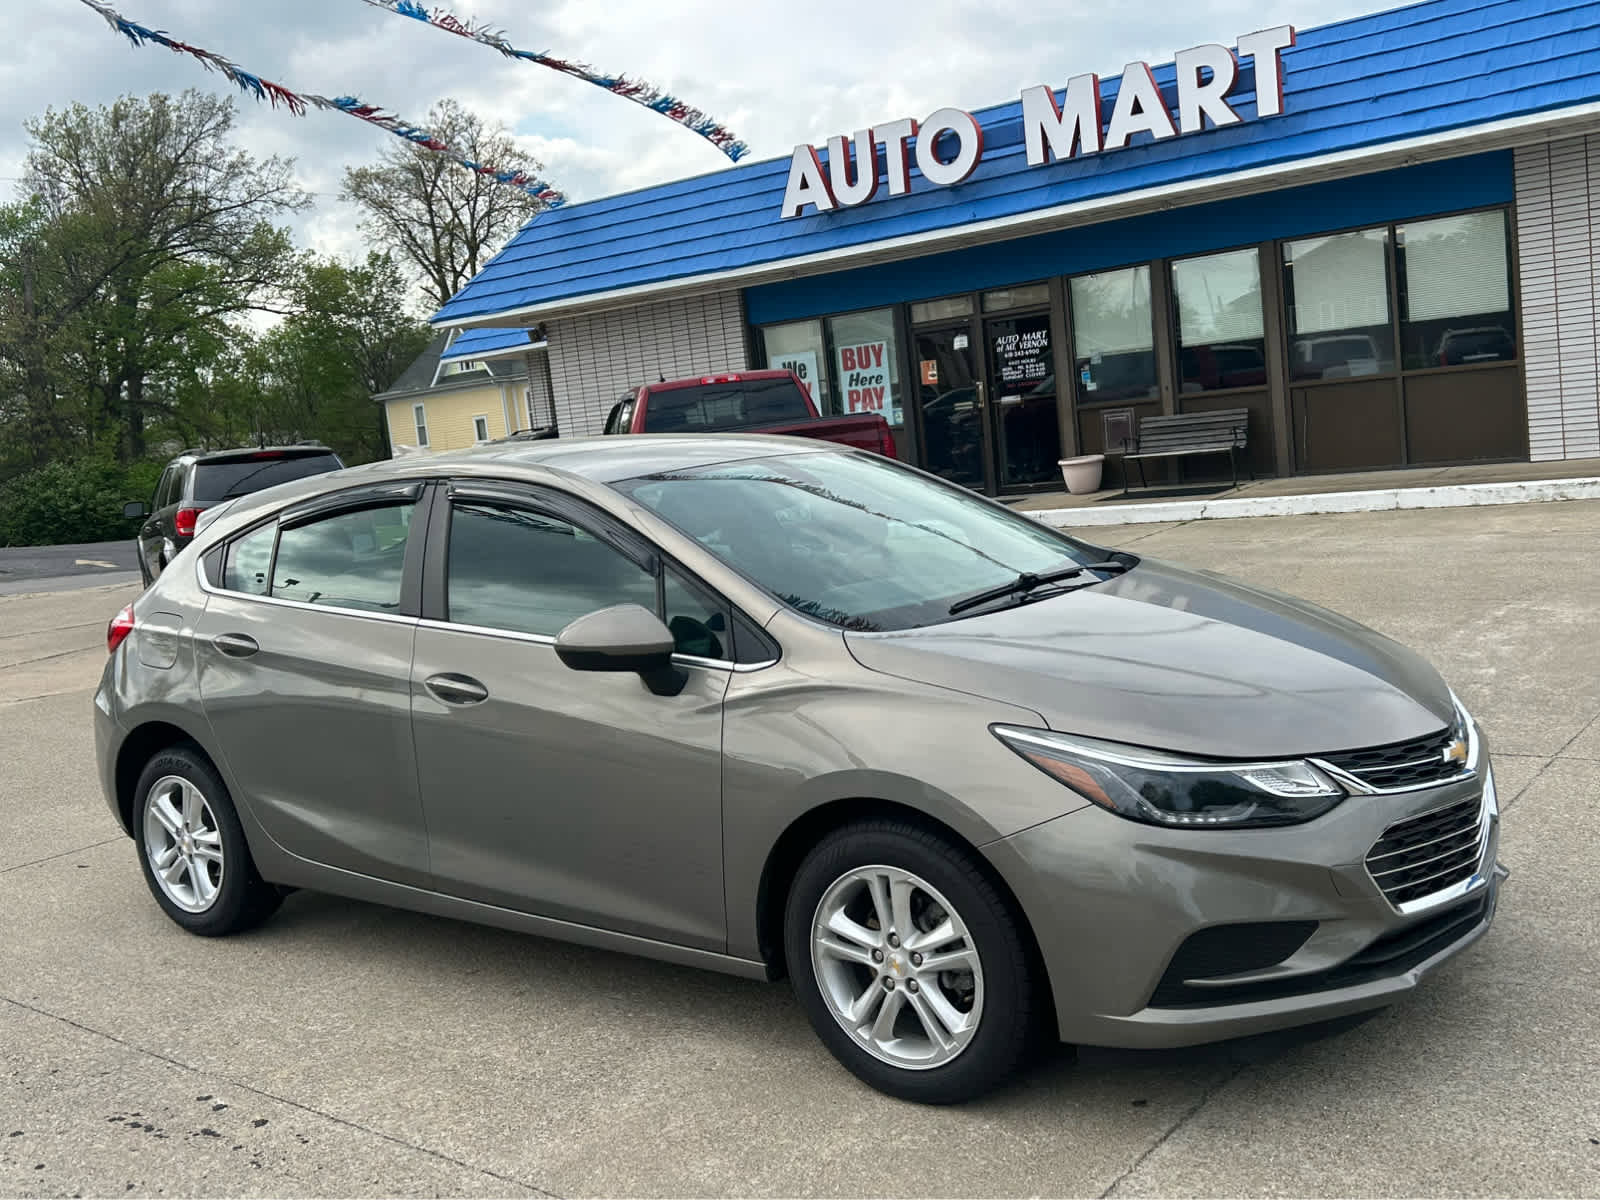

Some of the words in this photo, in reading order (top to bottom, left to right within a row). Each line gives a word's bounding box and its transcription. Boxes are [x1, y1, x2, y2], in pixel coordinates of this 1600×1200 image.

[781, 107, 983, 219] AUTO
[1021, 25, 1295, 166] MART
[996, 334, 1019, 344] AUTO
[1022, 330, 1047, 340] MART
[1019, 339, 1048, 348] VERNON
[841, 343, 884, 371] BUY
[848, 372, 884, 387] Here
[847, 386, 886, 413] PAY
